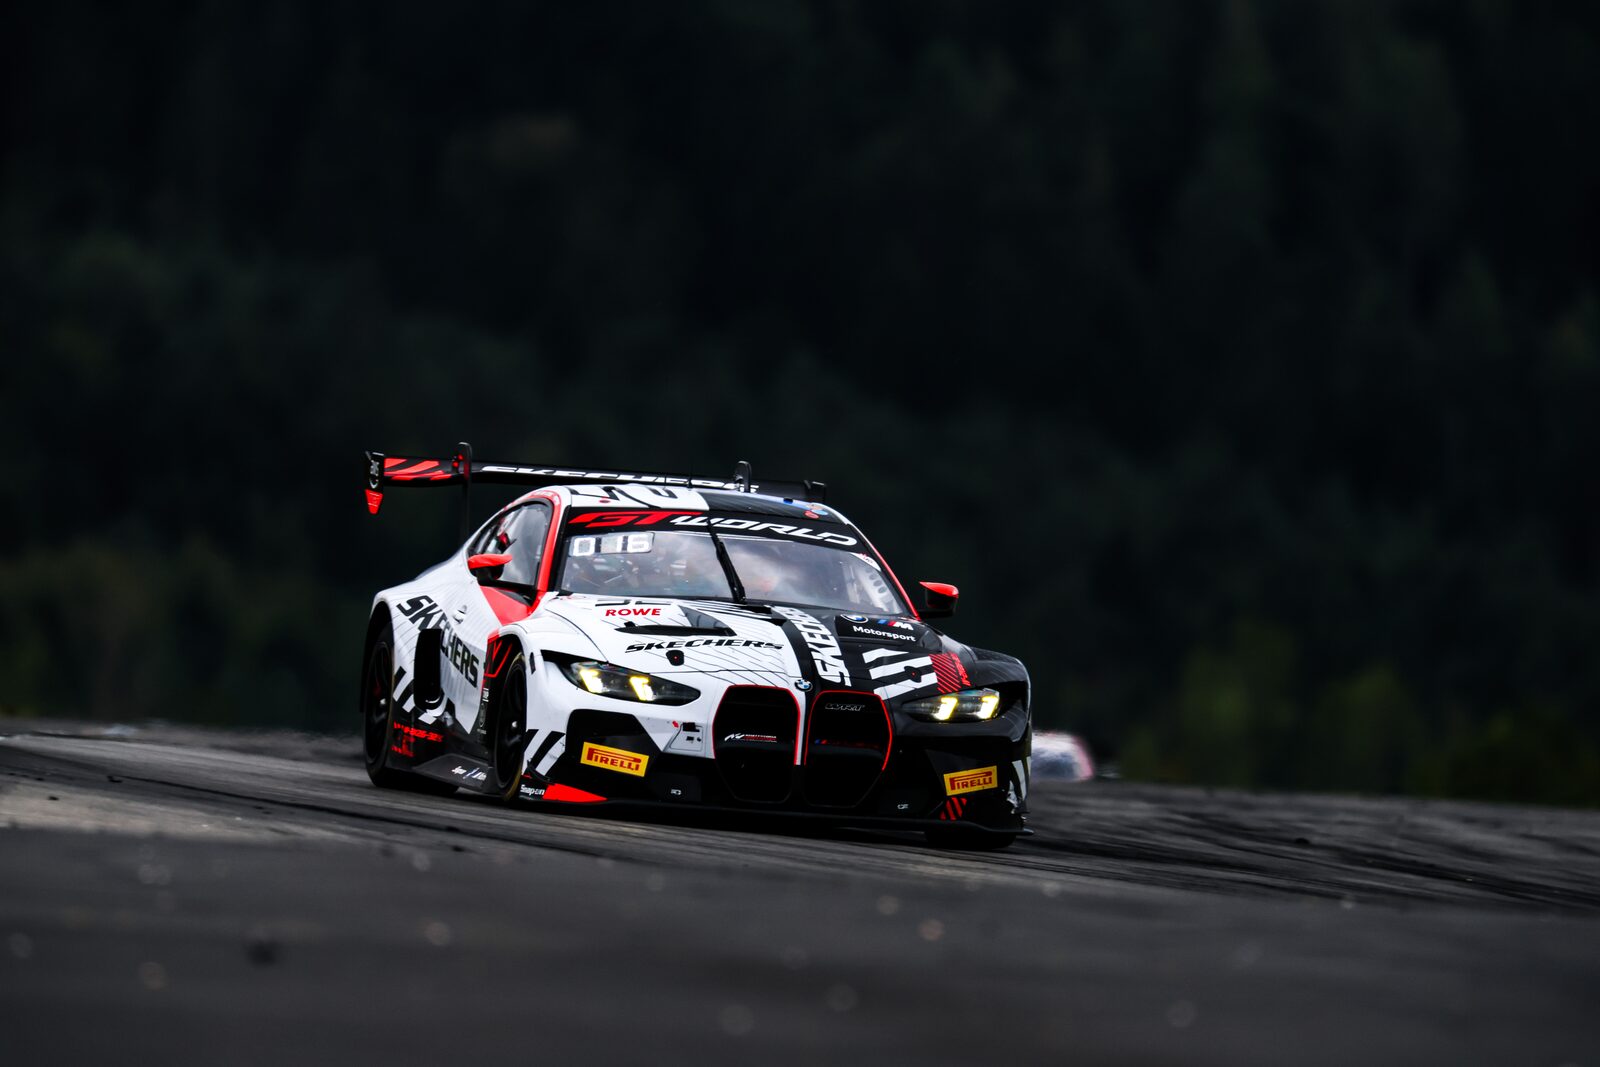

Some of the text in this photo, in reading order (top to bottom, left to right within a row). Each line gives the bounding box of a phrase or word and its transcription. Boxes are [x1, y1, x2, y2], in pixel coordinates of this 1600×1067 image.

[568, 510, 858, 547] GT WORLD
[605, 608, 662, 617] ROWE
[852, 625, 916, 642] Motorsport
[625, 638, 785, 654] SKECHERS
[586, 747, 642, 771] PIRELLI
[949, 770, 993, 791] PIRELLI
